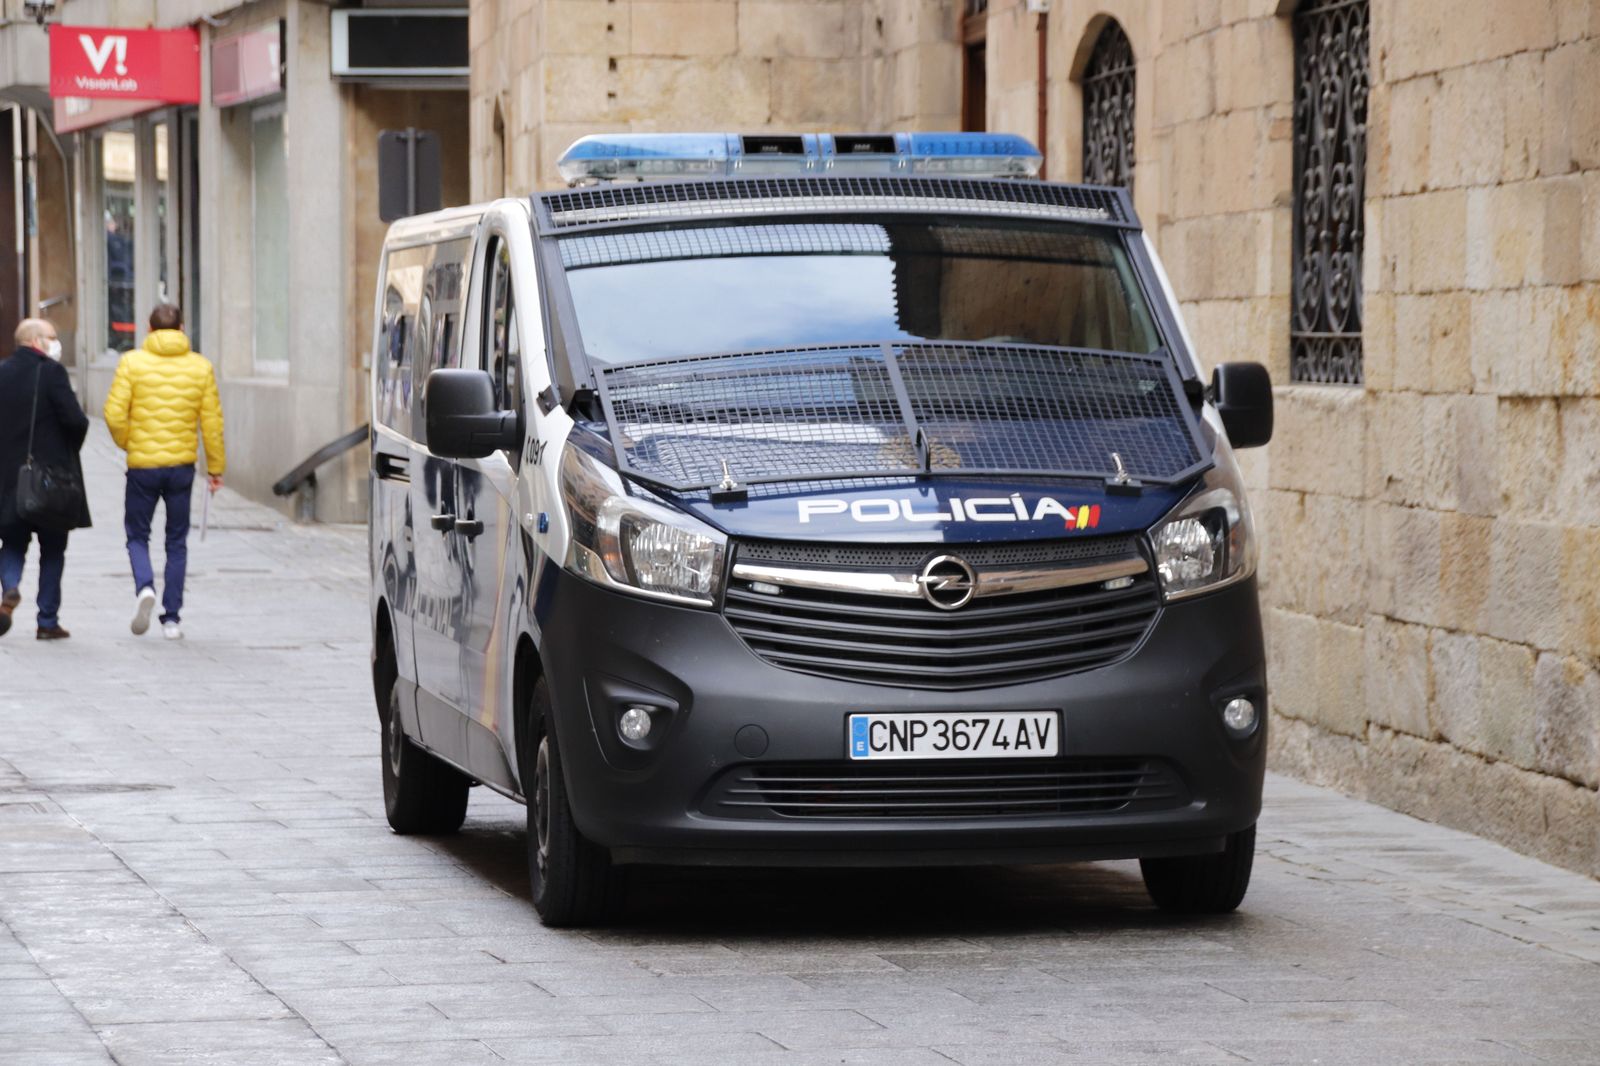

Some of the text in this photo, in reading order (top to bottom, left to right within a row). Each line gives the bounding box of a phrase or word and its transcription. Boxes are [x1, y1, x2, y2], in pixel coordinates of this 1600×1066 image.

[75, 76, 138, 92] VisionLab
[798, 493, 1075, 523] POLICÍA
[856, 741, 865, 751] E
